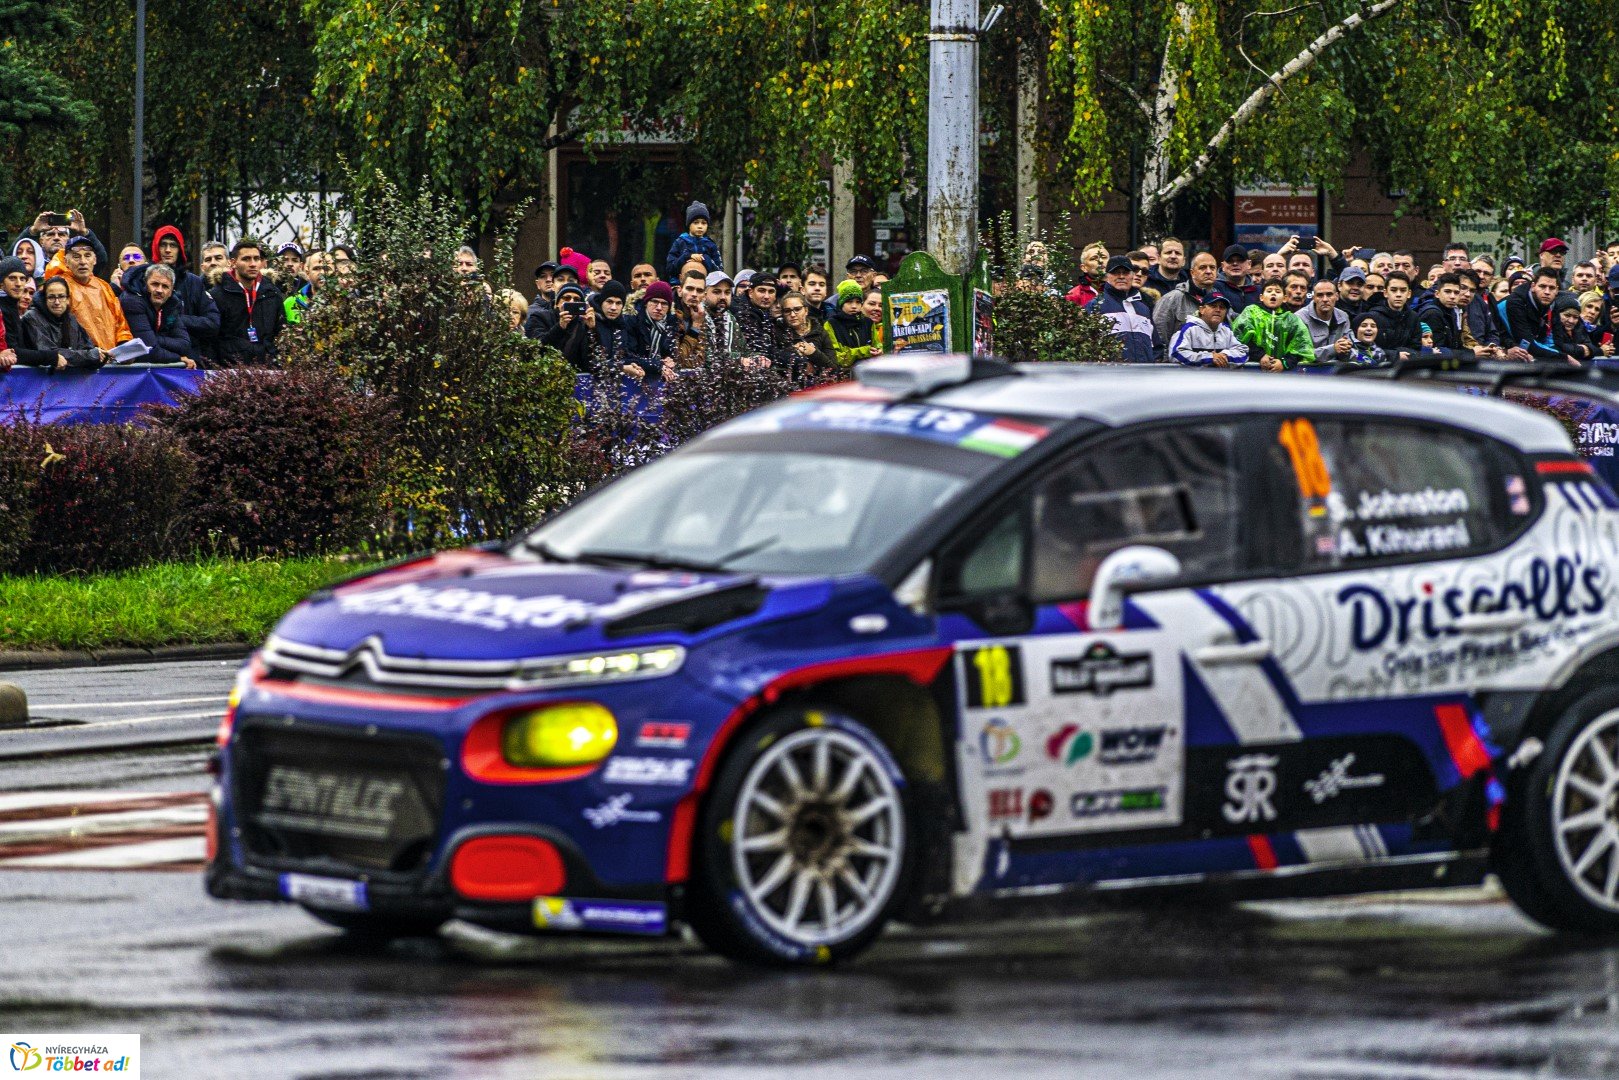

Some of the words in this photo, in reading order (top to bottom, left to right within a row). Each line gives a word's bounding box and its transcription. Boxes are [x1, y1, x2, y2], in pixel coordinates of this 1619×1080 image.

[1357, 486, 1469, 520] Johnston
[1339, 527, 1367, 557] A.
[1337, 553, 1604, 650] Driscoll's
